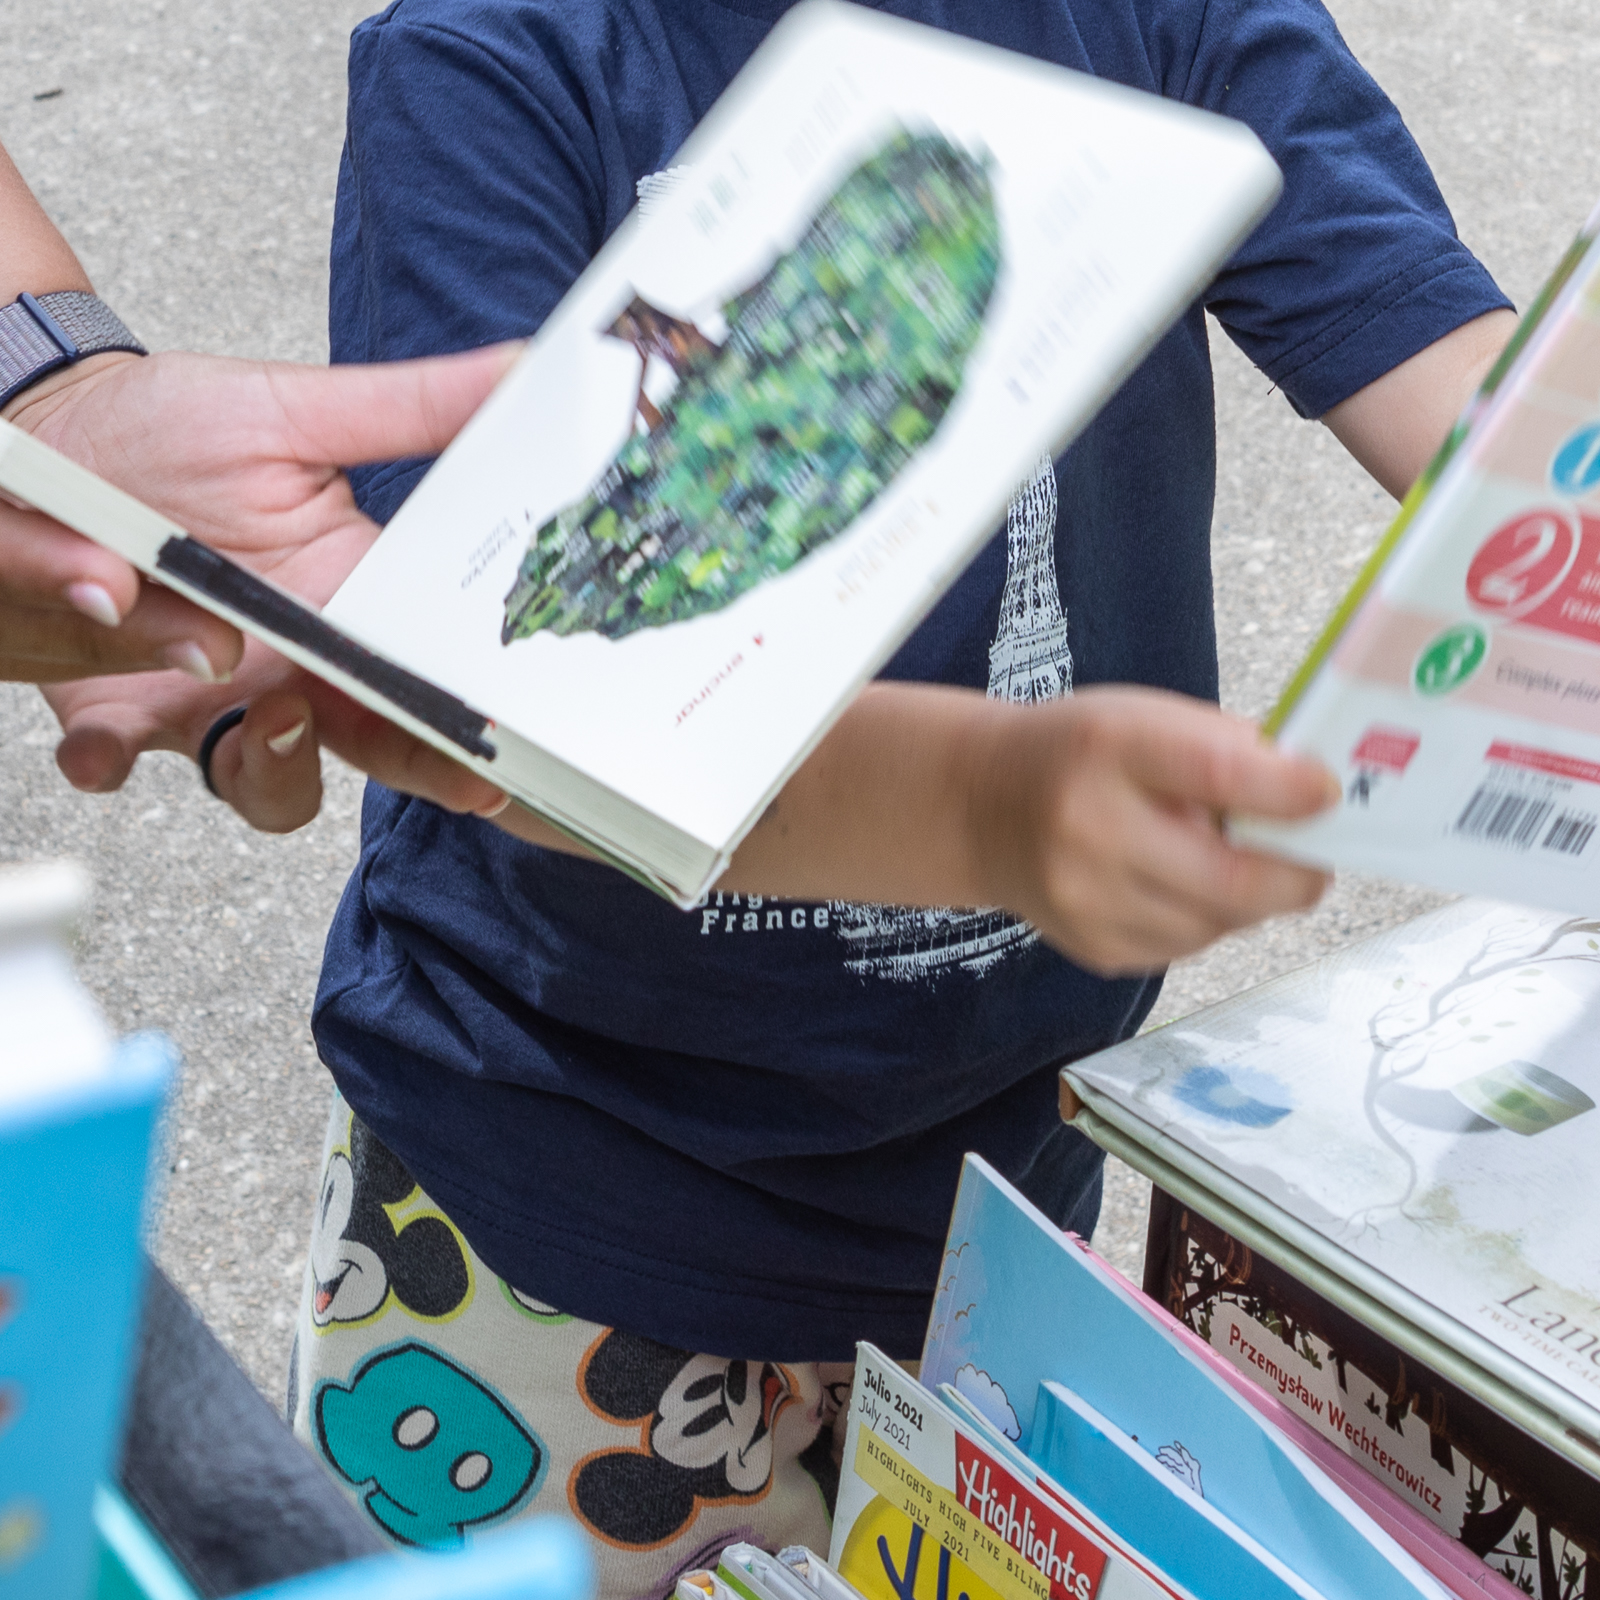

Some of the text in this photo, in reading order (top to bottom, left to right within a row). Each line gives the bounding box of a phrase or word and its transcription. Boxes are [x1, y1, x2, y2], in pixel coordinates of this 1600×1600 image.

[1477, 517, 1558, 605] 2
[700, 906, 830, 935] France
[1477, 1304, 1565, 1362] TWO-TIME
[858, 1394, 912, 1451] July 2021
[863, 1367, 925, 1433] Julio 2021
[1228, 1322, 1443, 1514] Przemysław Wechterowicz
[866, 1439, 934, 1505] HIGHLIGHTS
[938, 1500, 967, 1534] HIGH
[973, 1529, 1001, 1562] FIVE
[902, 1497, 931, 1529] JULY
[942, 1529, 970, 1563] 2021
[958, 1458, 1092, 1600] Highlights
